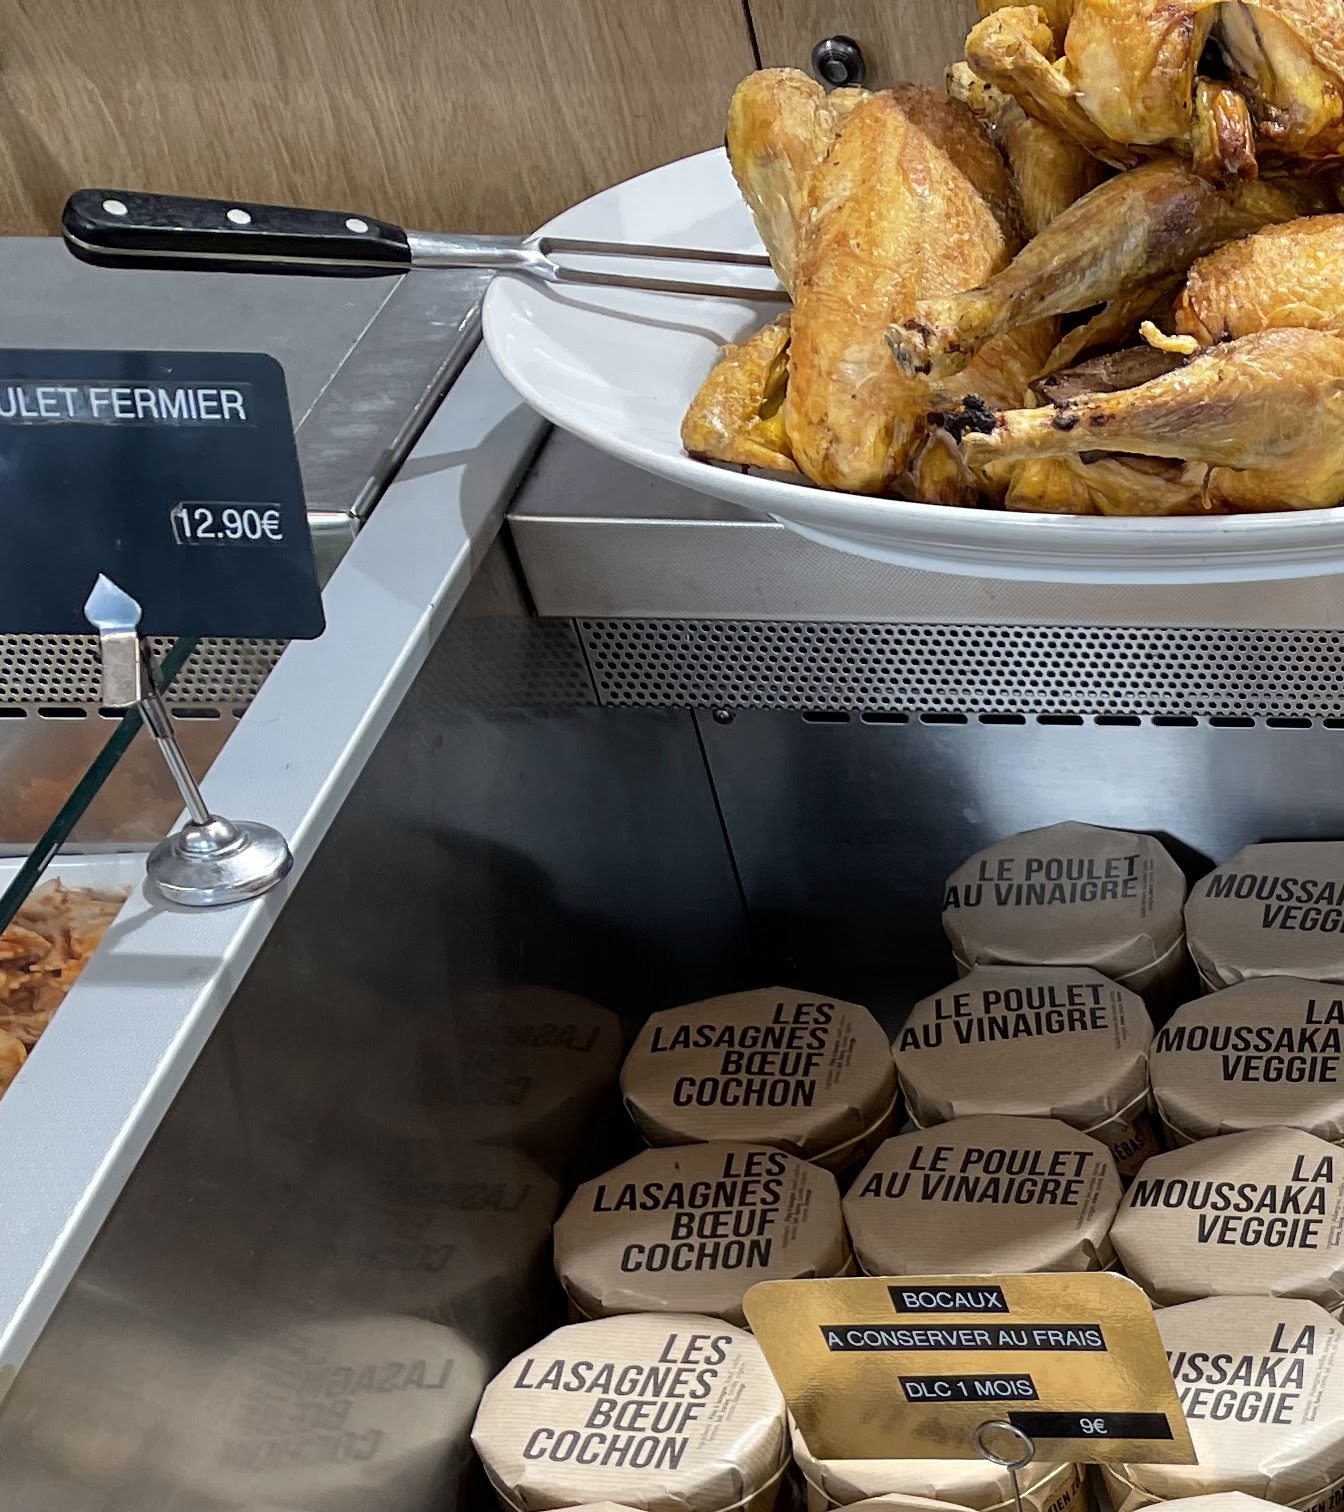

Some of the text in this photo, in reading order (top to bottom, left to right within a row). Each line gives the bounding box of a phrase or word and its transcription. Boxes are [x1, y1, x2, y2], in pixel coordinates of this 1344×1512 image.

[89, 388, 246, 420] FERMIER
[175, 508, 283, 540] 12.90€
[979, 855, 1139, 881] LE POULET
[943, 886, 983, 911] AU
[996, 878, 1137, 906] VINAIGRE
[772, 1003, 835, 1025] LES
[651, 1026, 829, 1052] LASAGNES
[721, 1051, 824, 1077] BŒUF
[673, 1078, 816, 1107] COCHON
[909, 1146, 1093, 1177] LE POULET
[1291, 1155, 1333, 1183] LA
[860, 1172, 912, 1198] AU
[921, 1174, 1084, 1205] VINAIGRE
[1130, 1179, 1326, 1215] MOUSSAKA
[1197, 1214, 1322, 1249] VEGGIE
[902, 1292, 1001, 1308] BOCAUX
[659, 1334, 733, 1365] LES
[828, 1331, 1102, 1347] A CONSERVER AU FRAIS
[513, 1359, 718, 1399] LASAGNES
[906, 1380, 1034, 1398] DLC 1 MOIS
[585, 1398, 706, 1433] BŒUF
[1080, 1418, 1107, 1434] 9€
[523, 1428, 689, 1469] COCHON
